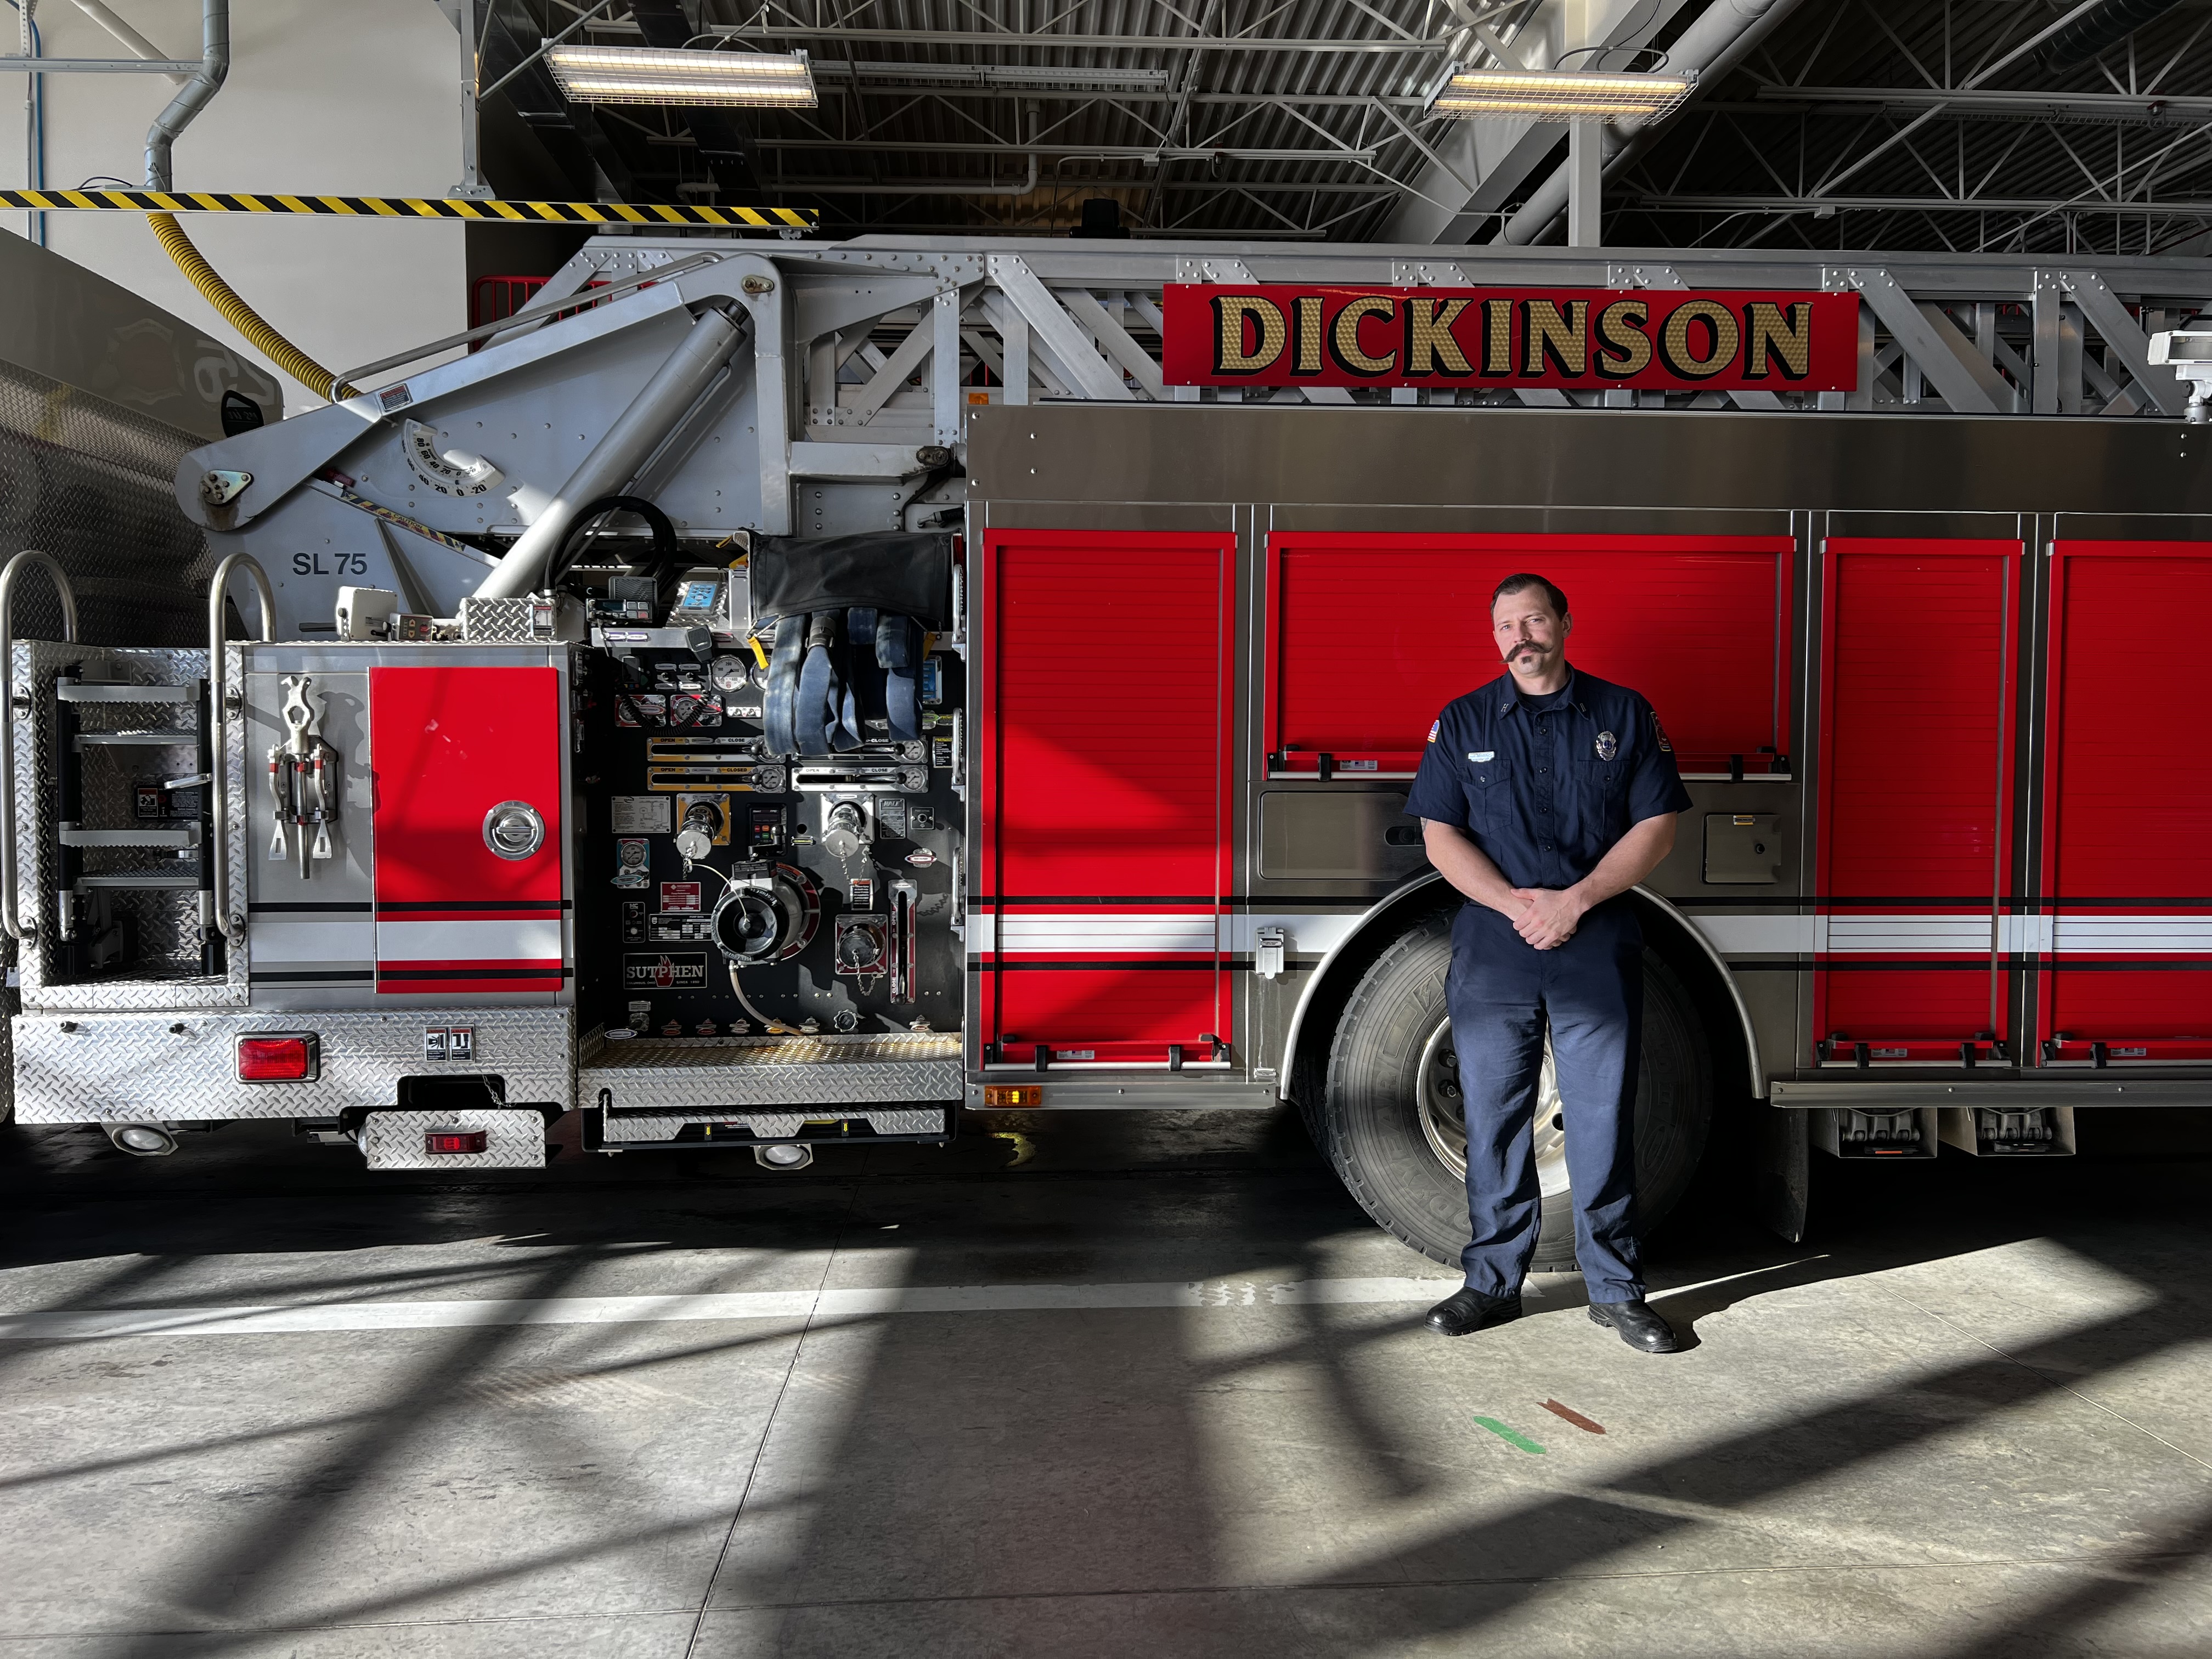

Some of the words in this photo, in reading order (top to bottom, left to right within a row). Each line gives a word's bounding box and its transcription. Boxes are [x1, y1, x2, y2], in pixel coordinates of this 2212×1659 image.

[1210, 295, 1813, 382] DICKINSON
[416, 437, 425, 447] 80
[421, 450, 431, 459] 60
[430, 461, 440, 469] 40
[419, 474, 429, 486] 40
[434, 484, 448, 494] 20
[470, 484, 487, 494] -20
[393, 514, 422, 529] CAUTION
[292, 552, 329, 575] SL
[334, 553, 368, 575] 75
[626, 965, 704, 979] SUTPHEN
